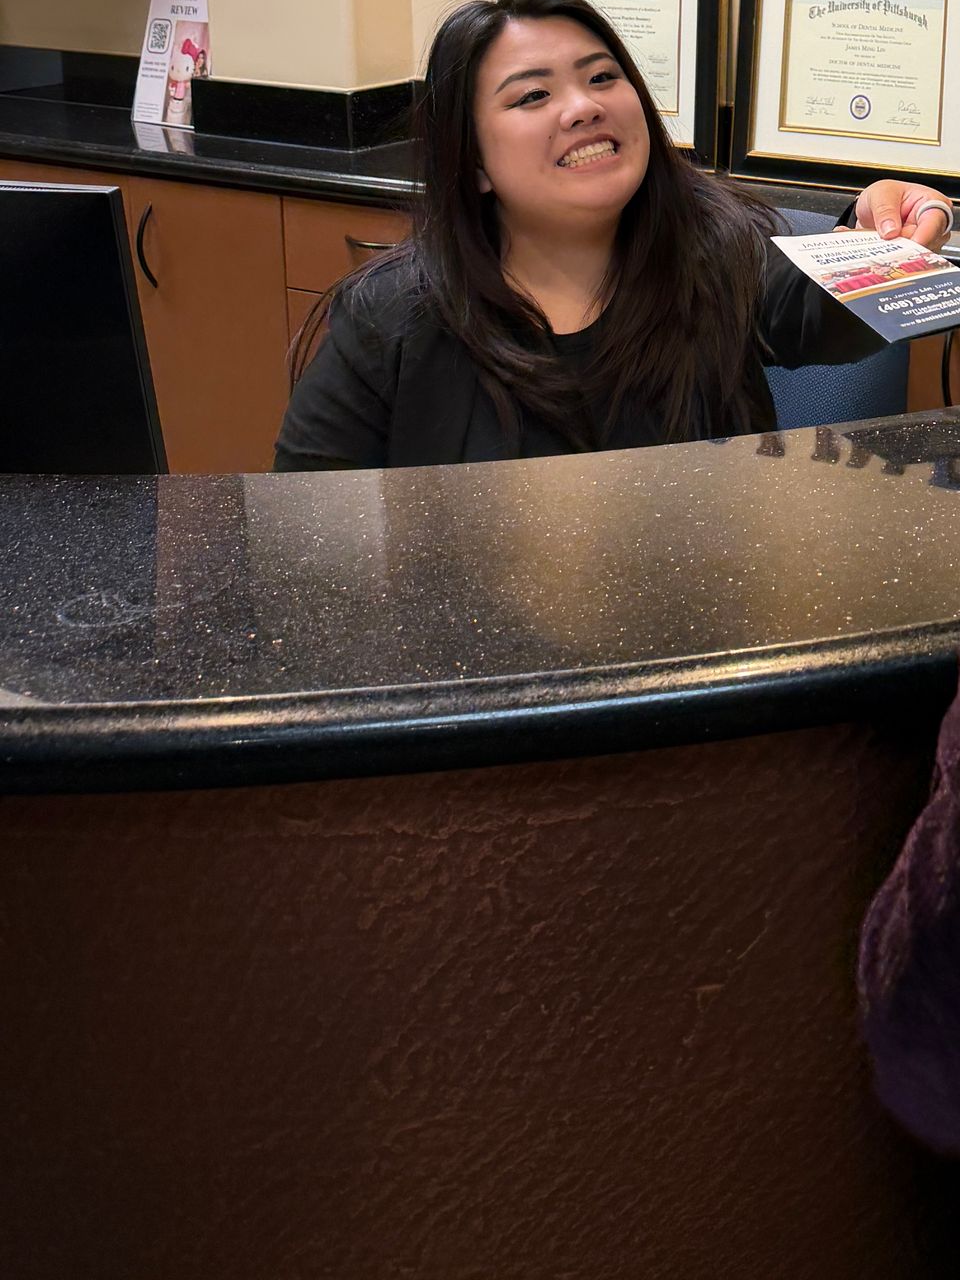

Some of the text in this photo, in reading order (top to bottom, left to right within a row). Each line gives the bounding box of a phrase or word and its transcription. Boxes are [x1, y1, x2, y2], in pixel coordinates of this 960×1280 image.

[170, 4, 198, 16] REVIEW
[808, 5, 826, 19] The
[872, 0, 883, 10] of
[883, 0, 928, 30] Pittsburgh
[878, 298, 914, 314] (408)
